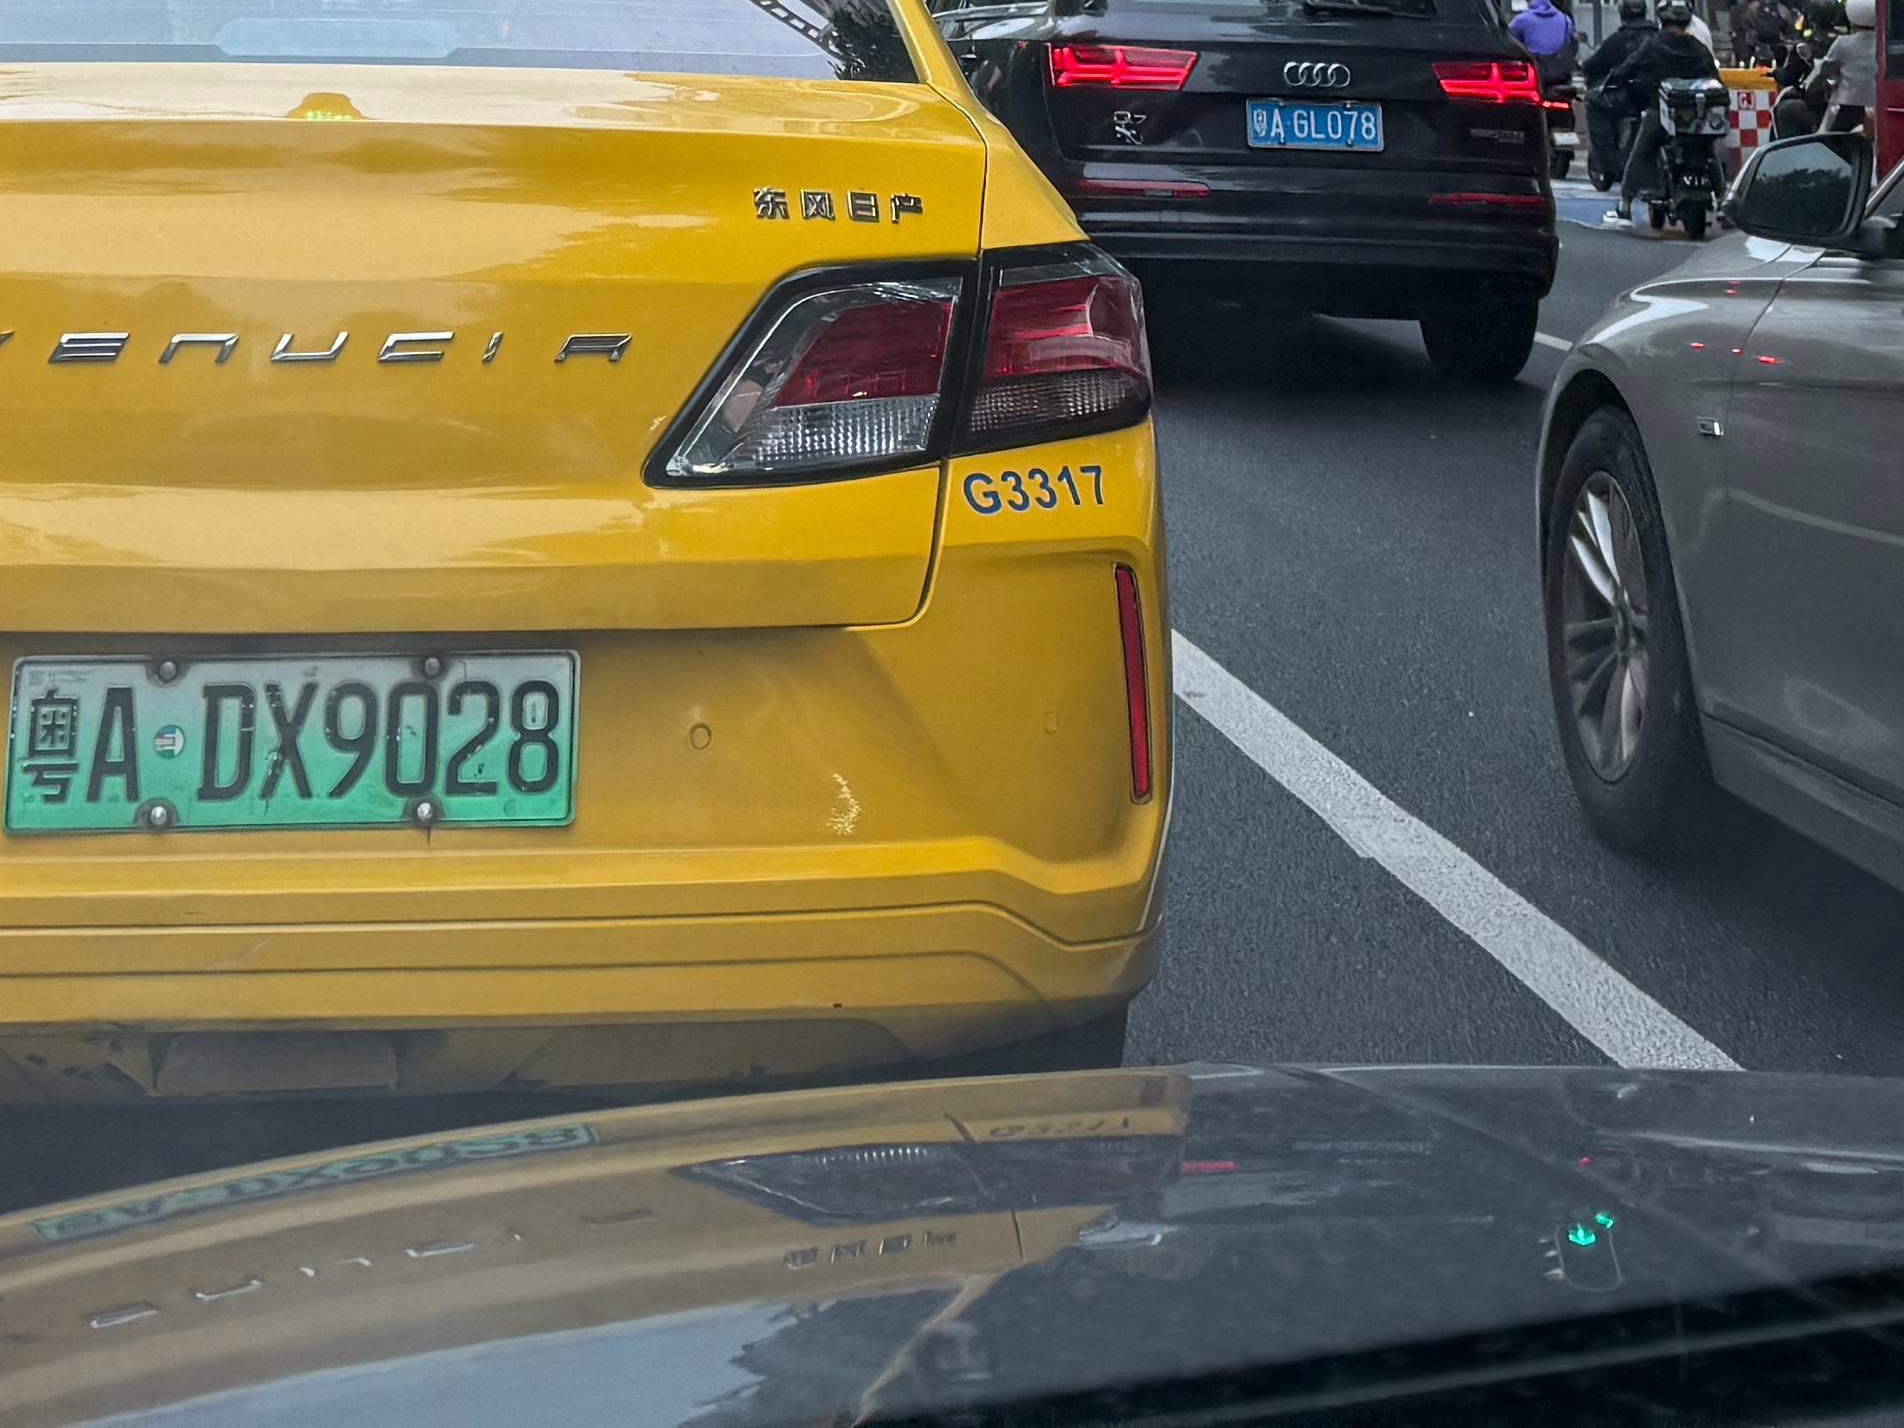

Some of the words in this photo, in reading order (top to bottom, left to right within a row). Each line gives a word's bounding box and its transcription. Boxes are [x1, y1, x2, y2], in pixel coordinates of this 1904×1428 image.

[753, 187, 924, 224] 东风日产
[963, 465, 1104, 514] G3317
